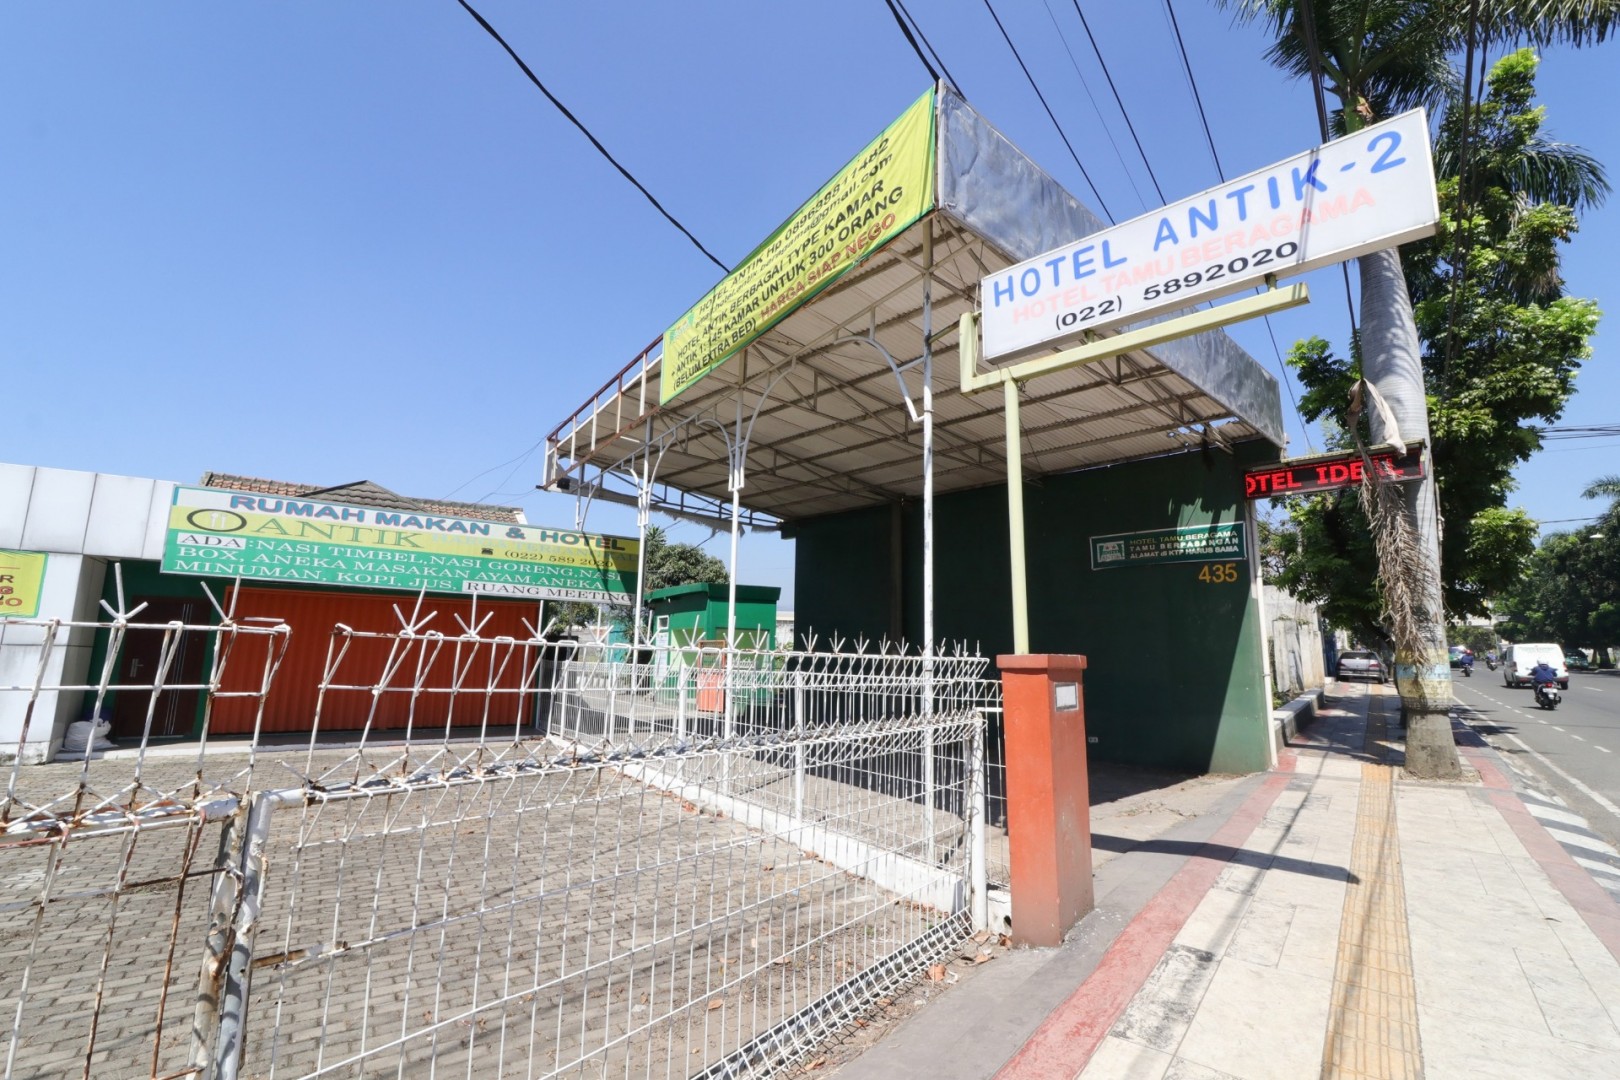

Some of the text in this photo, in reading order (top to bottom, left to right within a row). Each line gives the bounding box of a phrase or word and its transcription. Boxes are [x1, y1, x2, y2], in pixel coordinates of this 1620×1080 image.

[677, 334, 701, 359] HOTEL
[701, 311, 728, 337] ANTIK
[729, 260, 784, 314] BERBAGAI
[786, 230, 821, 264] TYPE
[823, 179, 884, 236] KAMAR
[699, 288, 728, 315] HOTEL
[731, 254, 763, 287] ANTIK
[766, 239, 782, 258] Hp
[994, 239, 1128, 308] HOTEL
[1012, 187, 1376, 325] HOTEL TAMU BERAGAMA
[676, 350, 698, 373] ANTIK
[723, 299, 760, 334] KAMAR
[761, 258, 806, 302] UNTUK
[808, 237, 835, 266] 300
[837, 185, 903, 242] ORANG
[702, 338, 732, 367] EXTRA
[731, 316, 758, 345] BED)
[760, 280, 806, 320] HARGA
[807, 251, 842, 286] SIAP
[845, 212, 896, 259] NEGO
[1055, 240, 1299, 331] (022) 5892020
[181, 534, 242, 548] ADA
[230, 495, 626, 552] RUMAH MAKAN & HOTEL
[251, 518, 425, 549] ANTIK
[1130, 544, 1156, 552] TAMU
[1160, 537, 1239, 550] BERPASANGAN
[1160, 535, 1184, 543] TAMU
[1185, 531, 1238, 541] BERAGAMA
[177, 546, 245, 562] BOX,
[251, 553, 348, 570] ANEKA
[353, 561, 470, 579] MASAKAN
[504, 549, 613, 568] (022) 589 2020
[1130, 551, 1160, 559] ALAMAT
[1169, 548, 1184, 557] KTP
[1185, 546, 1214, 556] HARUS
[1215, 544, 1240, 553] SAMA
[1198, 562, 1238, 584] 435
[174, 559, 632, 602] MINUMAN, KOPI, JUS, RUANG MEETING
